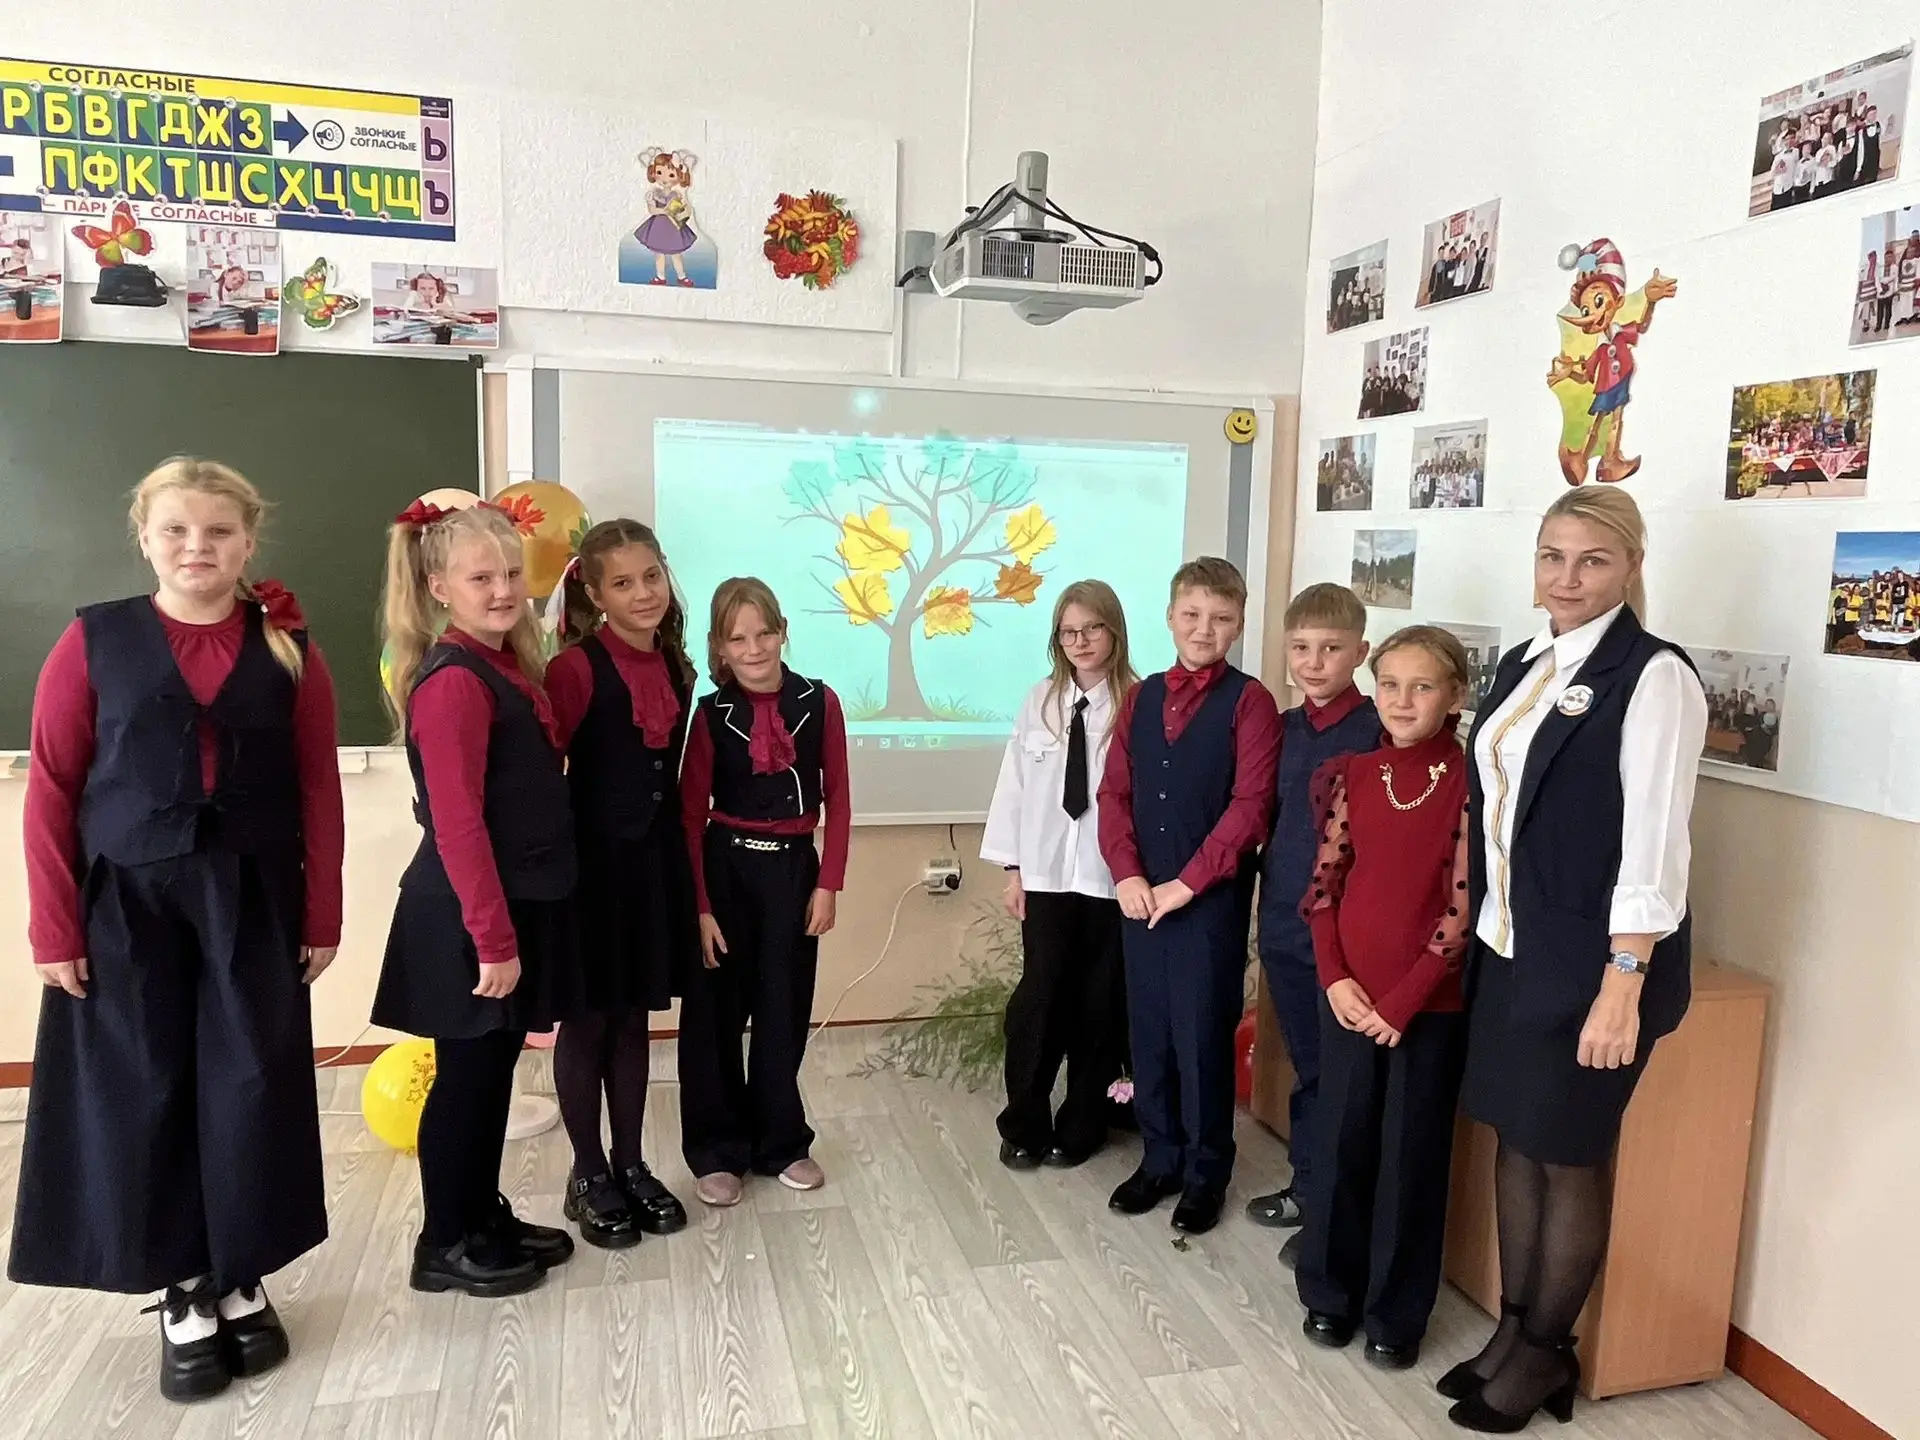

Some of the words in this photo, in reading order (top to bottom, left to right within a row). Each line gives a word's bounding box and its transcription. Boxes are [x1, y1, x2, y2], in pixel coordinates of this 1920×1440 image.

[48, 67, 196, 93] СОГЛАСНЫЕ
[355, 126, 406, 139] ЗВОНКИЕ
[350, 137, 417, 152] СОГЛАСНЫЕ
[151, 206, 257, 224] СОГЛАСНЫЕ
